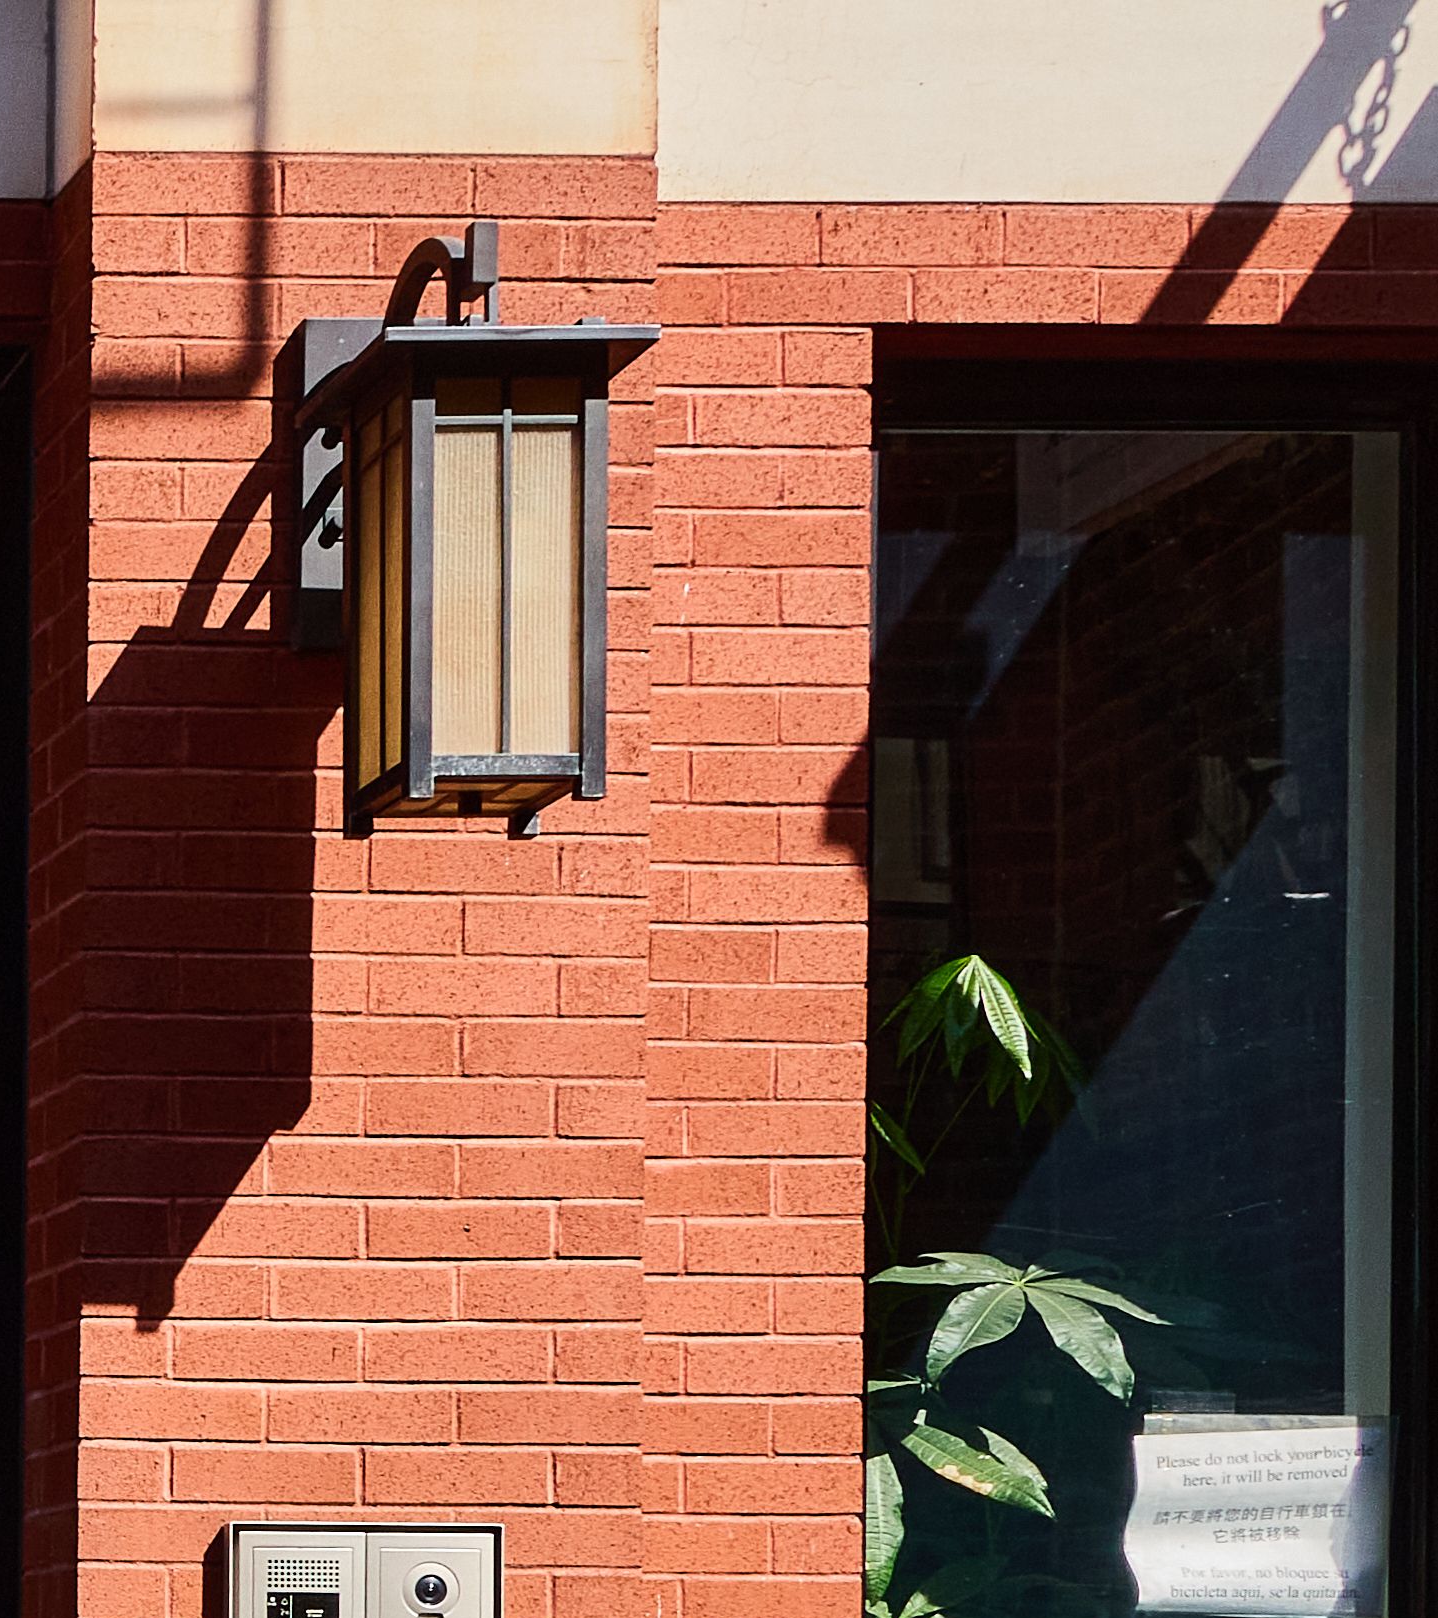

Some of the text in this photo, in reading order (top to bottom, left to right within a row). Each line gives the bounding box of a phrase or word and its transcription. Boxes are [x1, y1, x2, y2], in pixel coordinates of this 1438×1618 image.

[1156, 1443, 1374, 1469] Please do not lock your bicycle
[1183, 1464, 1348, 1487] here, it will be removed
[1255, 1568, 1273, 1579] no
[1276, 1565, 1329, 1582] bloquee
[1170, 1584, 1228, 1599] bicicleta
[1269, 1587, 1284, 1599] se
[1287, 1584, 1300, 1599] la
